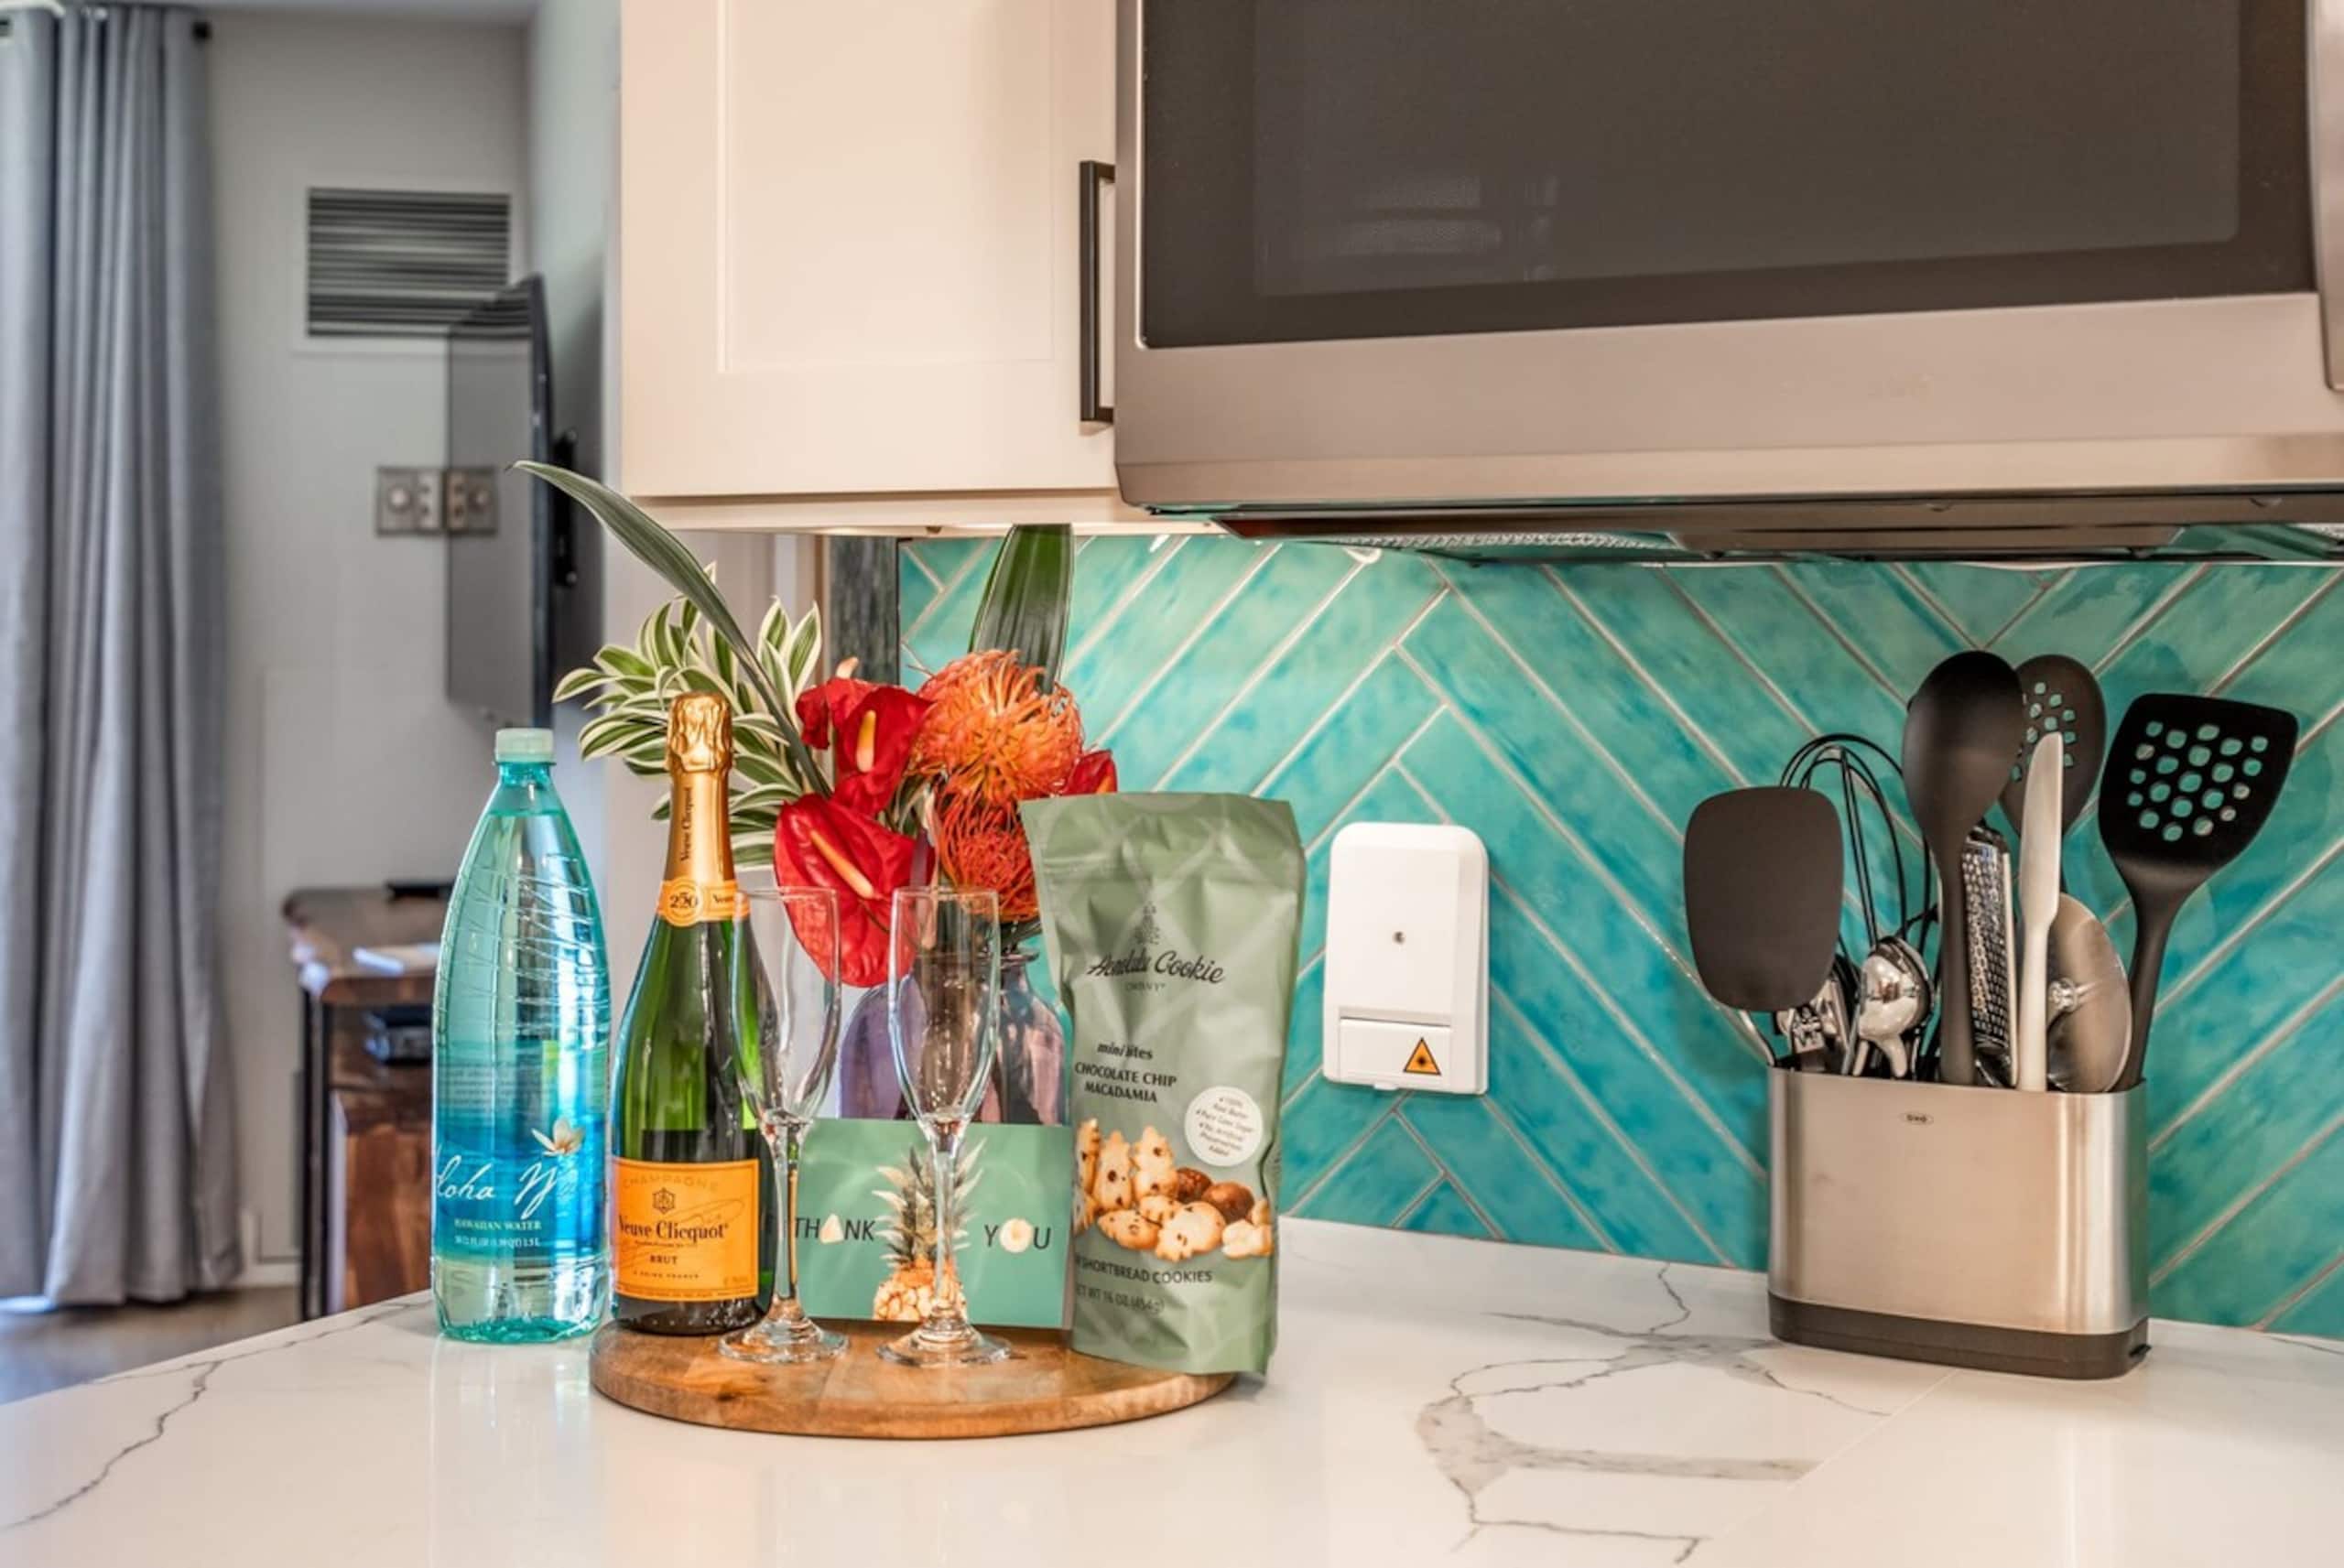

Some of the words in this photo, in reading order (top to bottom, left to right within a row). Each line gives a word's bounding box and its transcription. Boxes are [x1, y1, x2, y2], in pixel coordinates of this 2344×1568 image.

[1154, 950, 1225, 984] Cookie
[1074, 1062, 1140, 1084] CHOCOLATE
[1142, 1072, 1177, 1087] CHIP
[1084, 1081, 1158, 1103] MACADAMIA
[436, 1152, 496, 1201] loha
[984, 1218, 1052, 1253] YOU
[649, 1255, 678, 1265] BRUT
[1152, 1271, 1213, 1284] COOKIES
